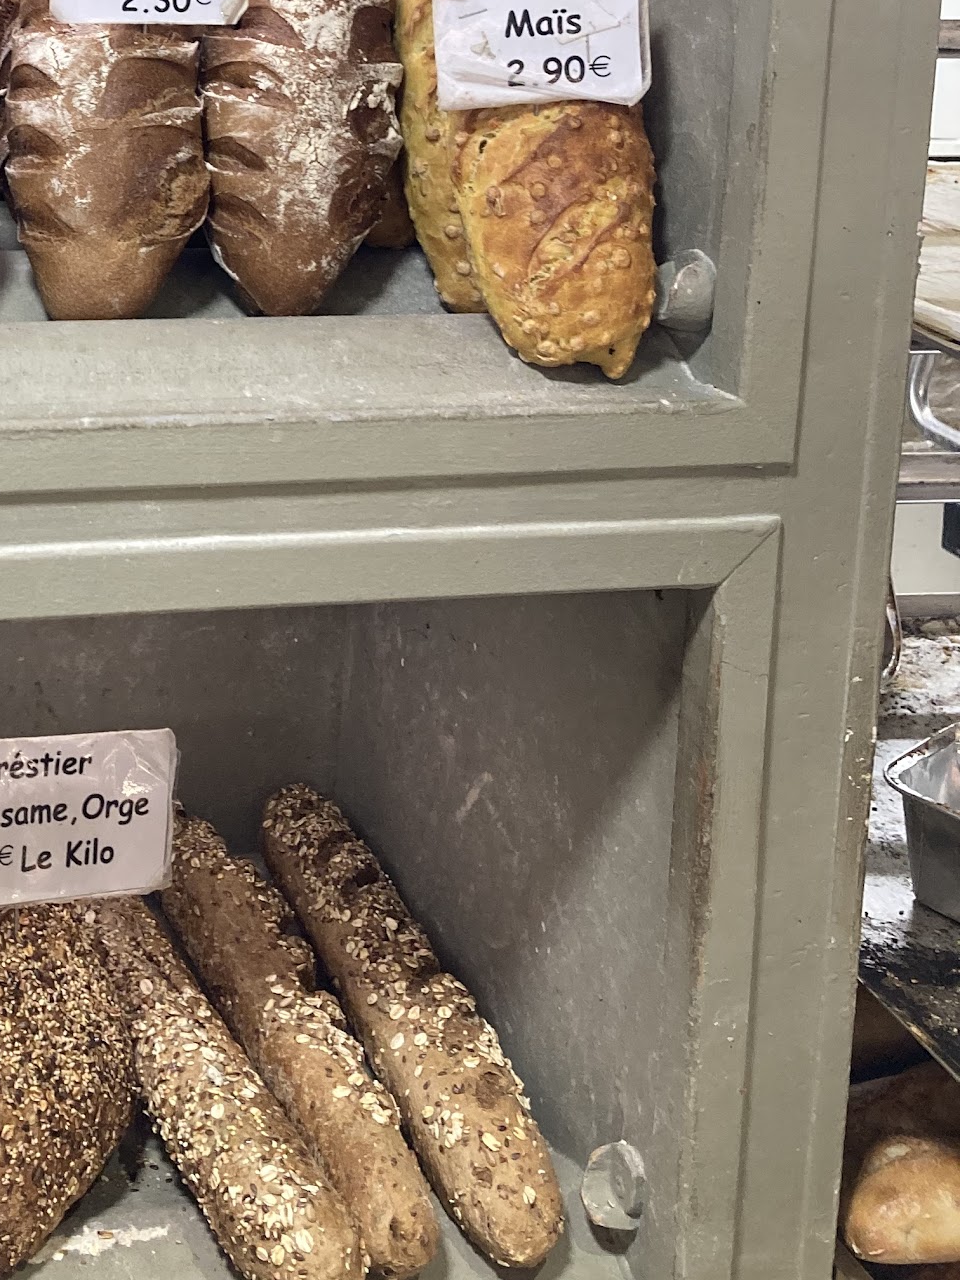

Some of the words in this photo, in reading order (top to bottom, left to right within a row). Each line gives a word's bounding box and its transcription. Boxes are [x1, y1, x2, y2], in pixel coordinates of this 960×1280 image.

[505, 9, 581, 38] Maïs
[21, 845, 52, 873] Le
[65, 837, 115, 868] Kilo
